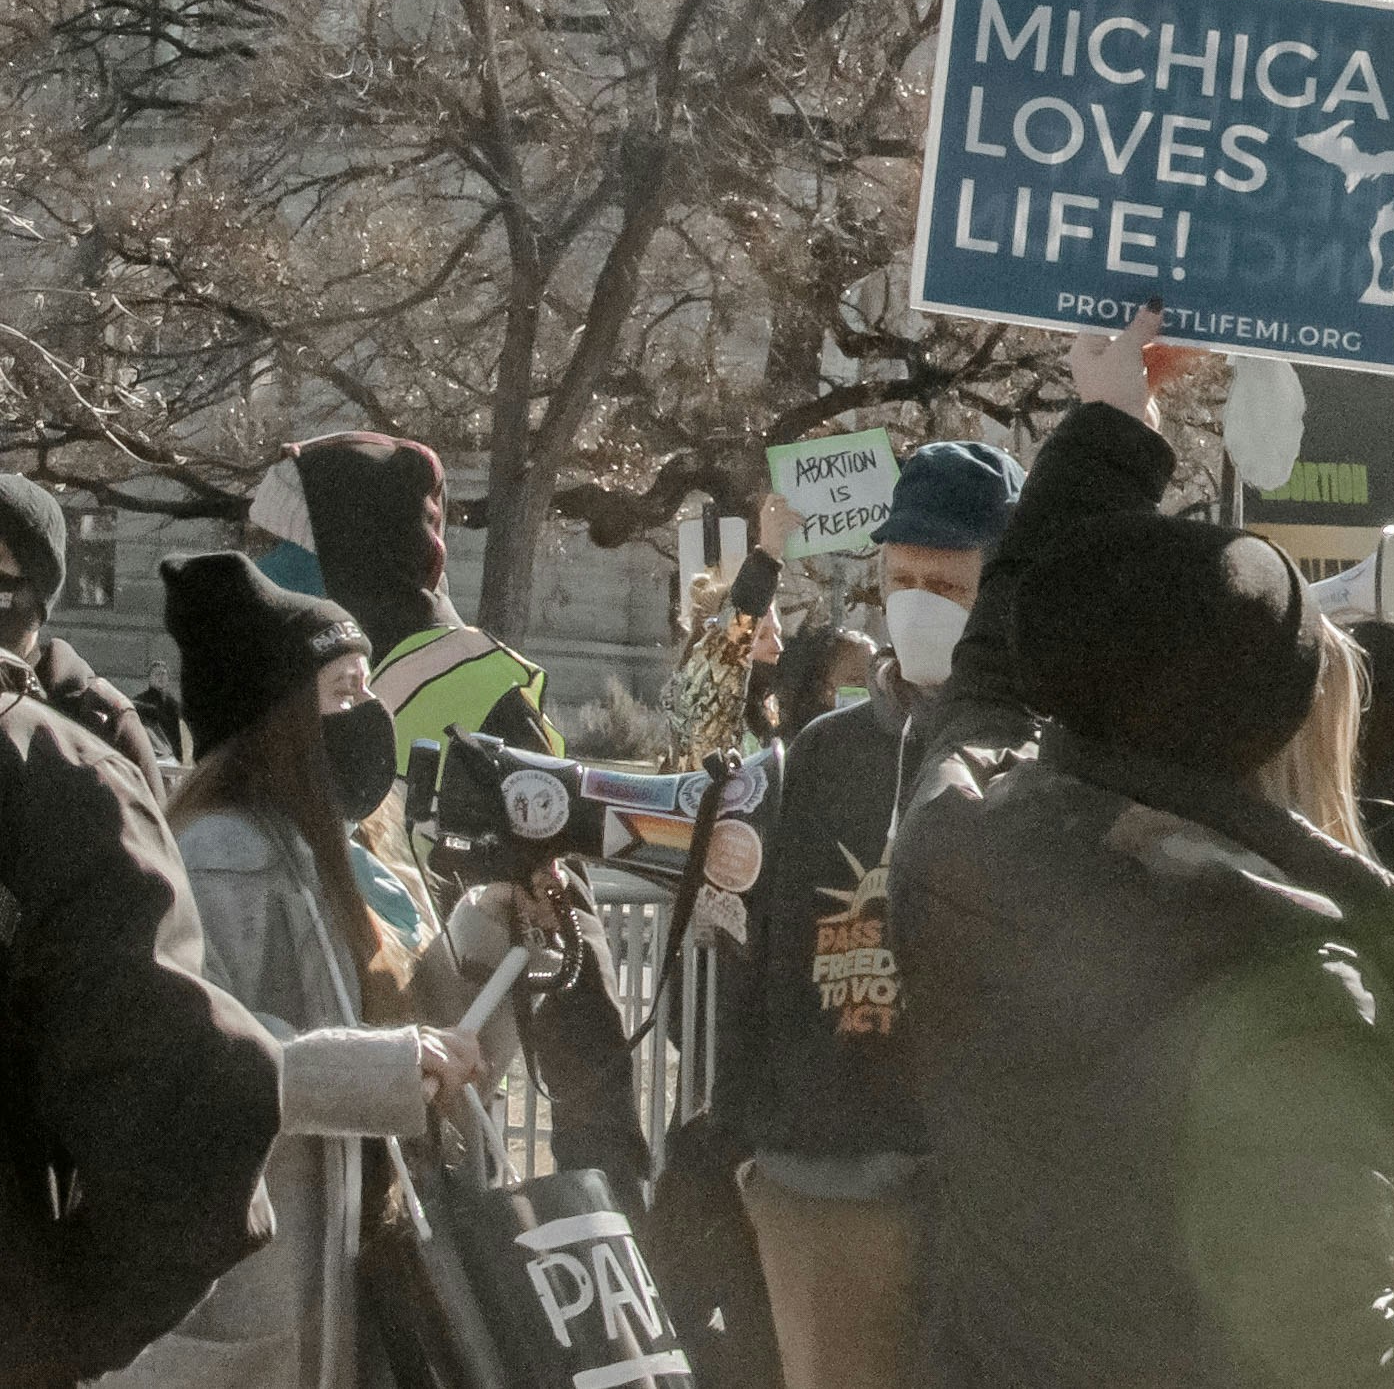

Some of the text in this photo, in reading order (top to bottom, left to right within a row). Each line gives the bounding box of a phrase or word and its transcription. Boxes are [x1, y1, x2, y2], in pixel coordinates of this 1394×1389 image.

[964, 86, 1271, 193] LOVES
[954, 179, 1191, 282] LIFE!
[1057, 292, 1362, 353] PROTCTLIFEMI.ORG
[796, 449, 876, 486] ABORTION
[830, 486, 851, 503] IS
